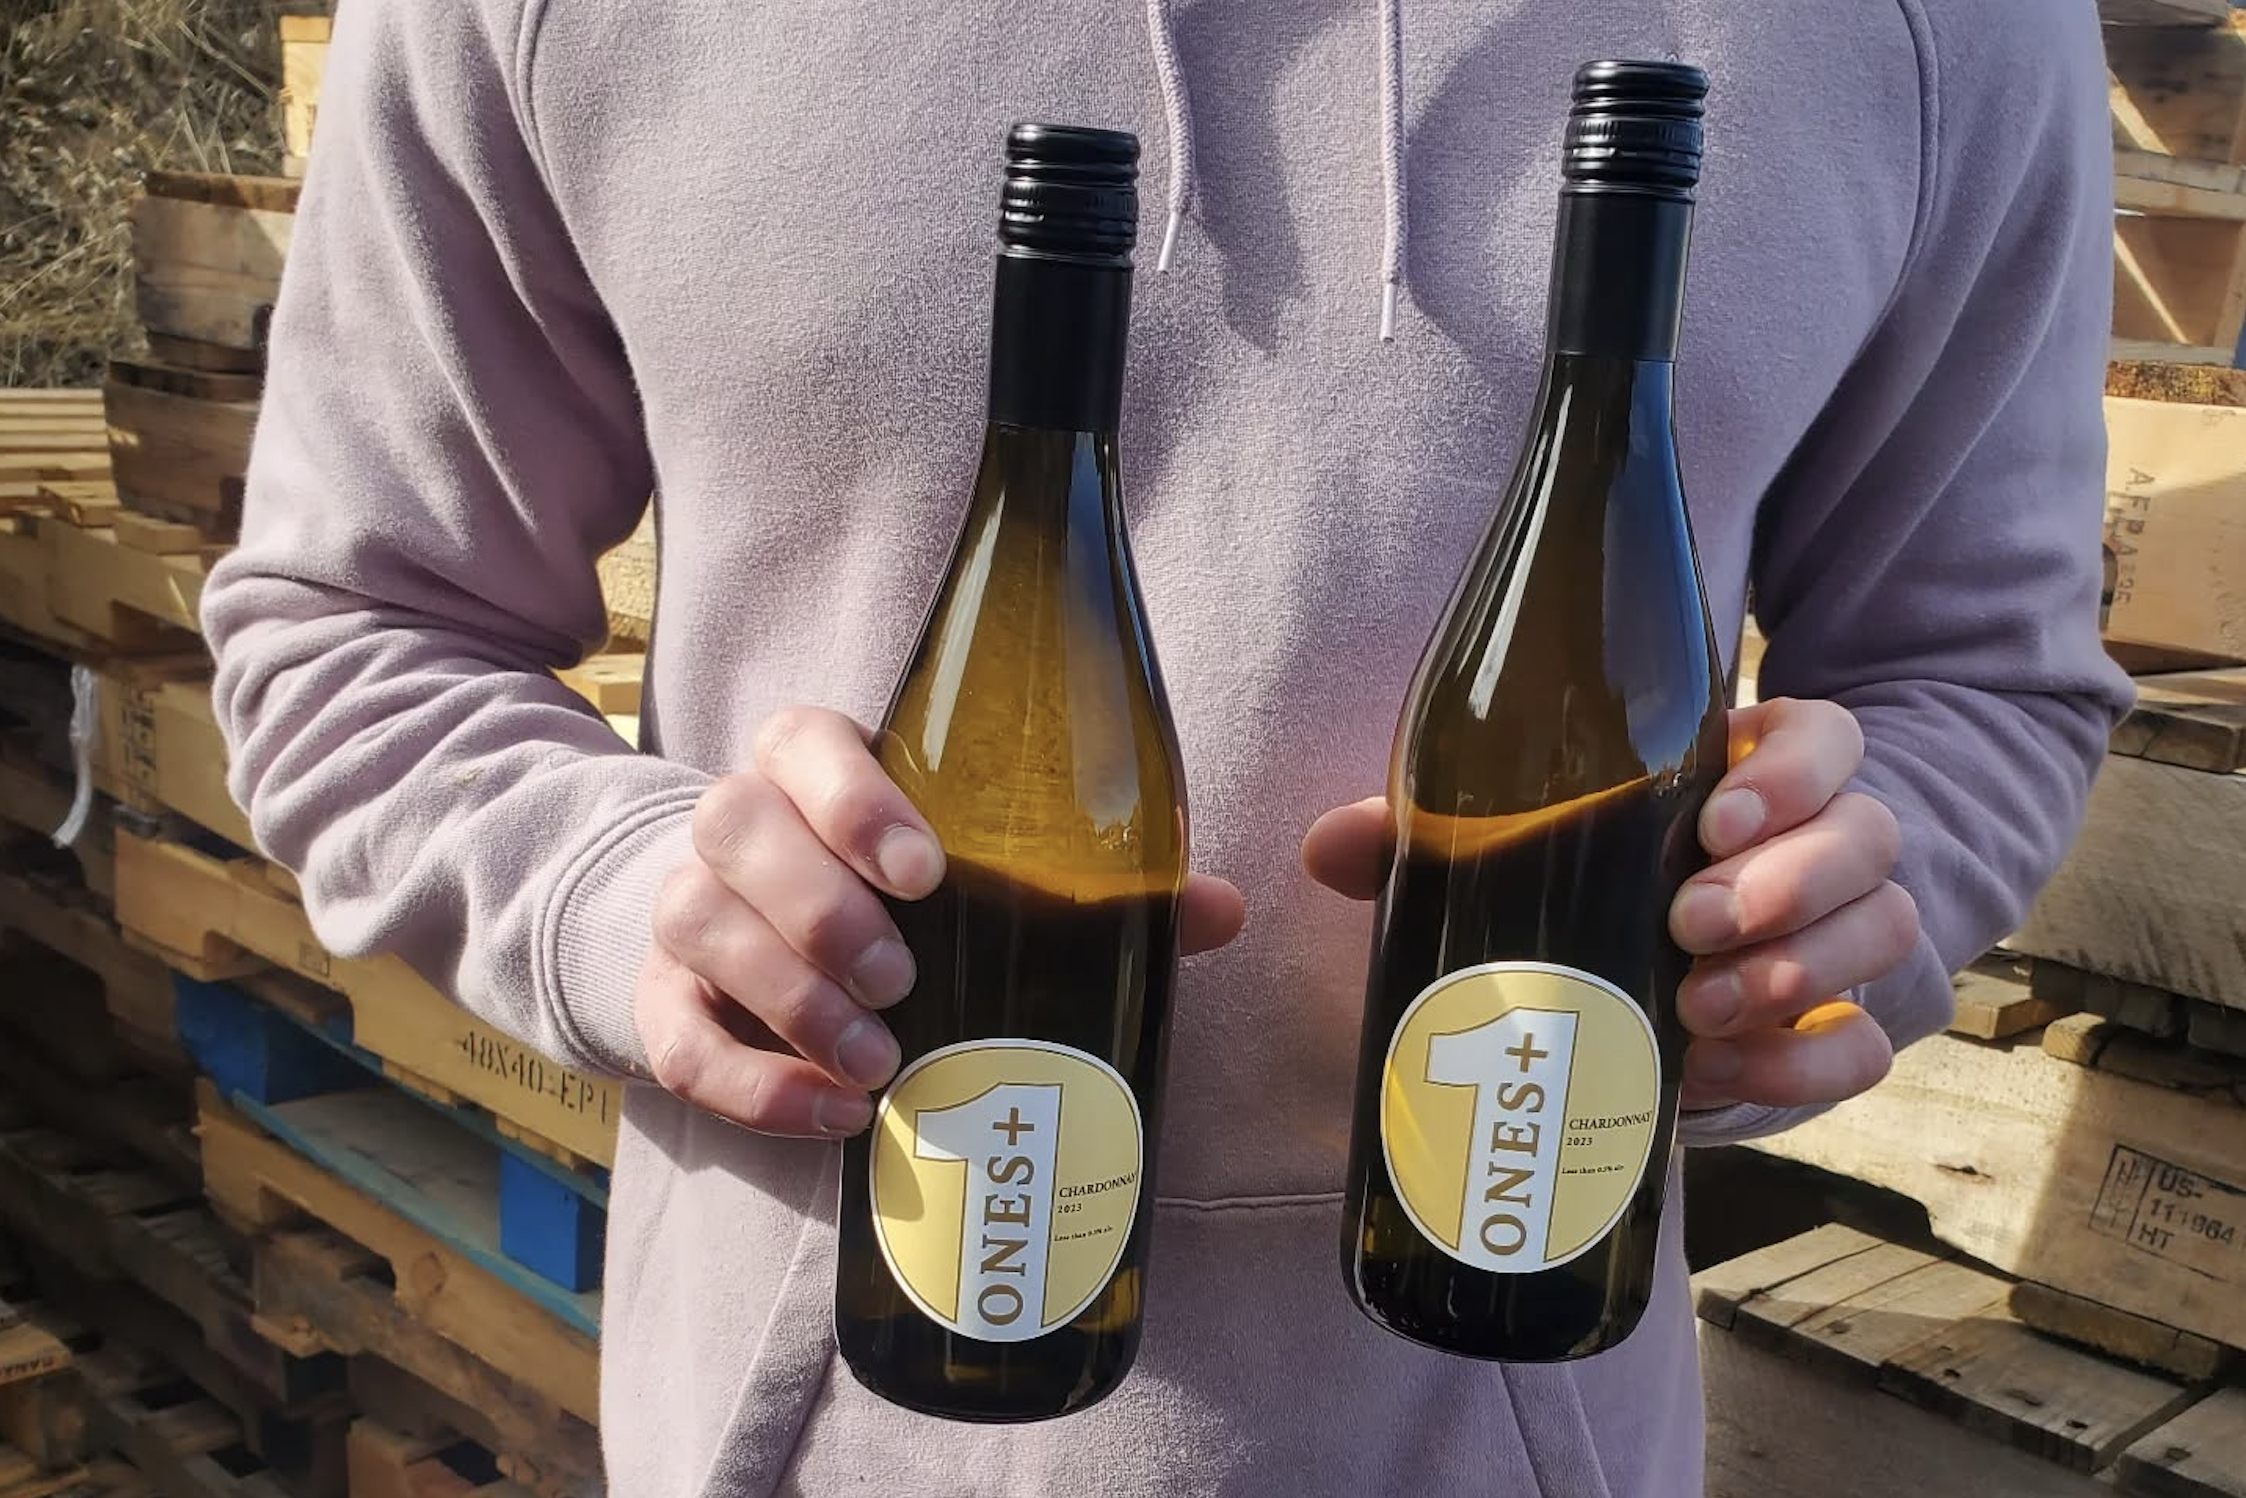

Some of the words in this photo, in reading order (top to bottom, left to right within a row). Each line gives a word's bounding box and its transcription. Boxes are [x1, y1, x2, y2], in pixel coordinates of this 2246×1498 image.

[1569, 1110, 1653, 1130] CHARDONNAY
[1479, 1032, 1549, 1256] ONES+
[1566, 1137, 1593, 1146] 2023
[1059, 1173, 1136, 1198] CHARDONNAY
[977, 1107, 1035, 1326] ONES+
[1057, 1203, 1082, 1214] 2023
[2138, 1222, 2176, 1250] HT
